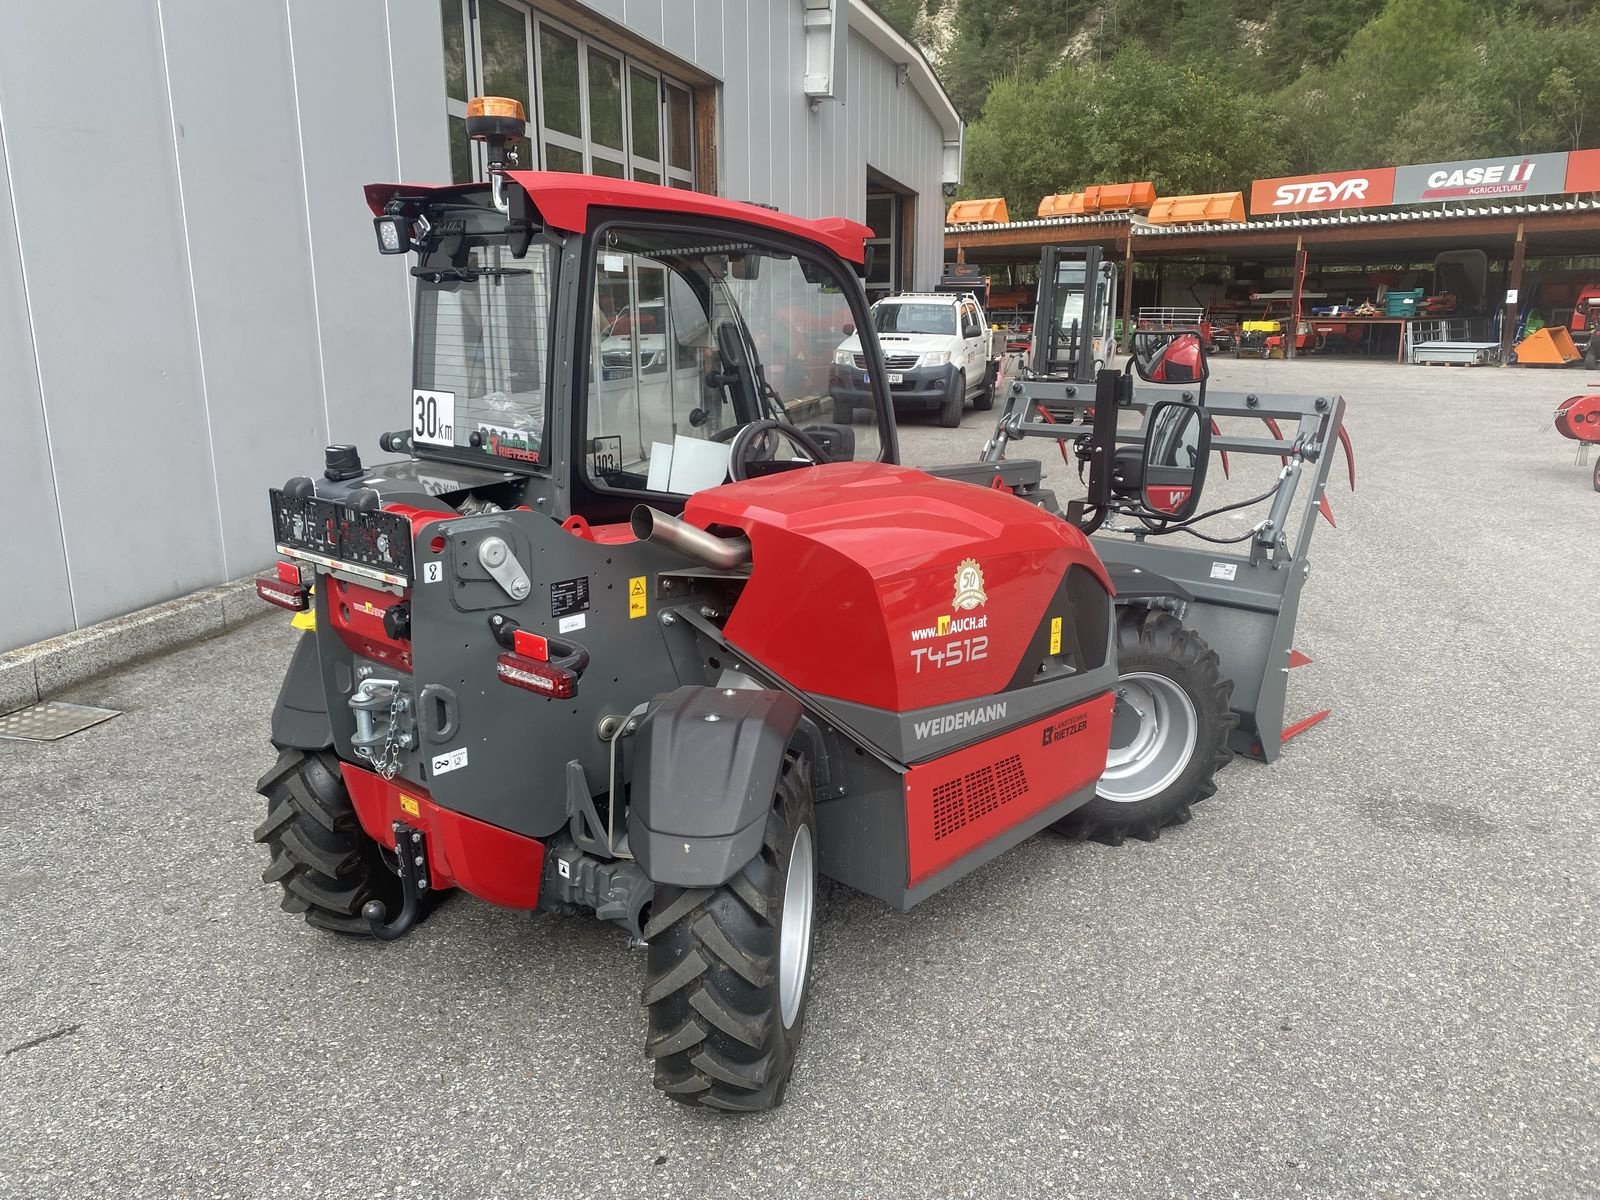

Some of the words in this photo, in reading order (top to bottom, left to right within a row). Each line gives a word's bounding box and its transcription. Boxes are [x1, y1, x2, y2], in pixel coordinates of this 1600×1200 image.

[1427, 165, 1505, 188] CASE
[1272, 178, 1370, 206] STEYR
[1468, 184, 1523, 195] AGRICULTURE
[415, 395, 437, 438] 30
[438, 416, 453, 441] km
[499, 446, 540, 463] RIETZLER
[500, 439, 540, 451] LANDTECNIK
[596, 453, 613, 473] 103
[963, 571, 976, 589] 50
[911, 615, 988, 642] www.MAUCH.at
[910, 635, 989, 674] T4512
[913, 701, 1007, 740] WEIDEMANN
[1053, 720, 1088, 742] RIETZLER
